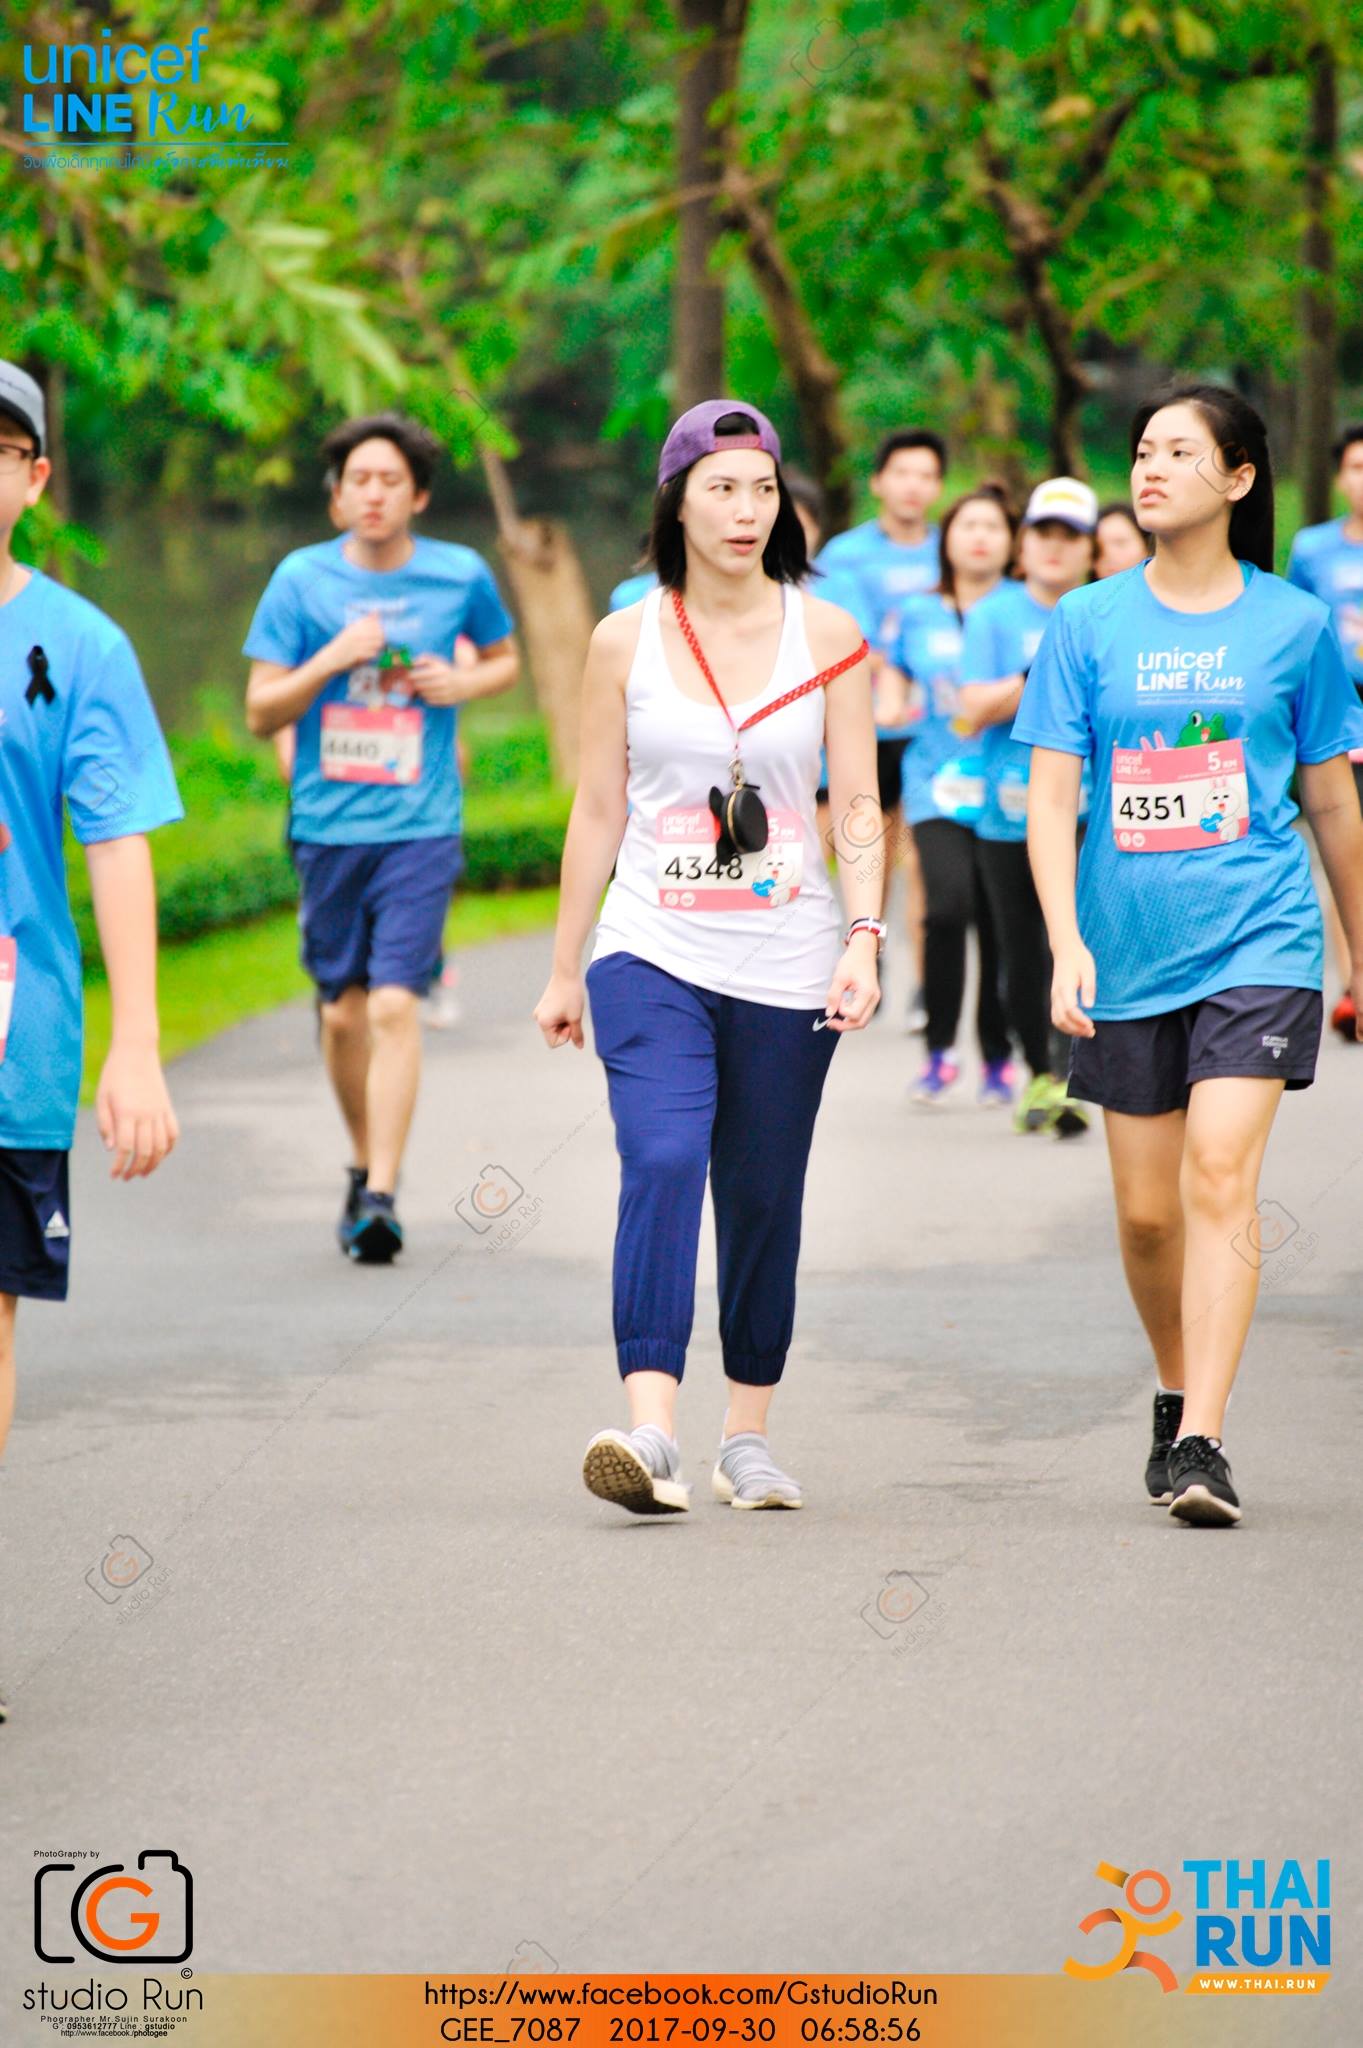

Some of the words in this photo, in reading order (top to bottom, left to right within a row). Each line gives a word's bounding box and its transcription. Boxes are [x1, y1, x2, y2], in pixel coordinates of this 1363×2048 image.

[1137, 646, 1228, 670] unicef
[1136, 671, 1189, 691] LINE
[1194, 670, 1246, 692] Run
[1207, 751, 1221, 771] 5
[1119, 794, 1187, 822] 4351
[664, 855, 744, 880] 4348
